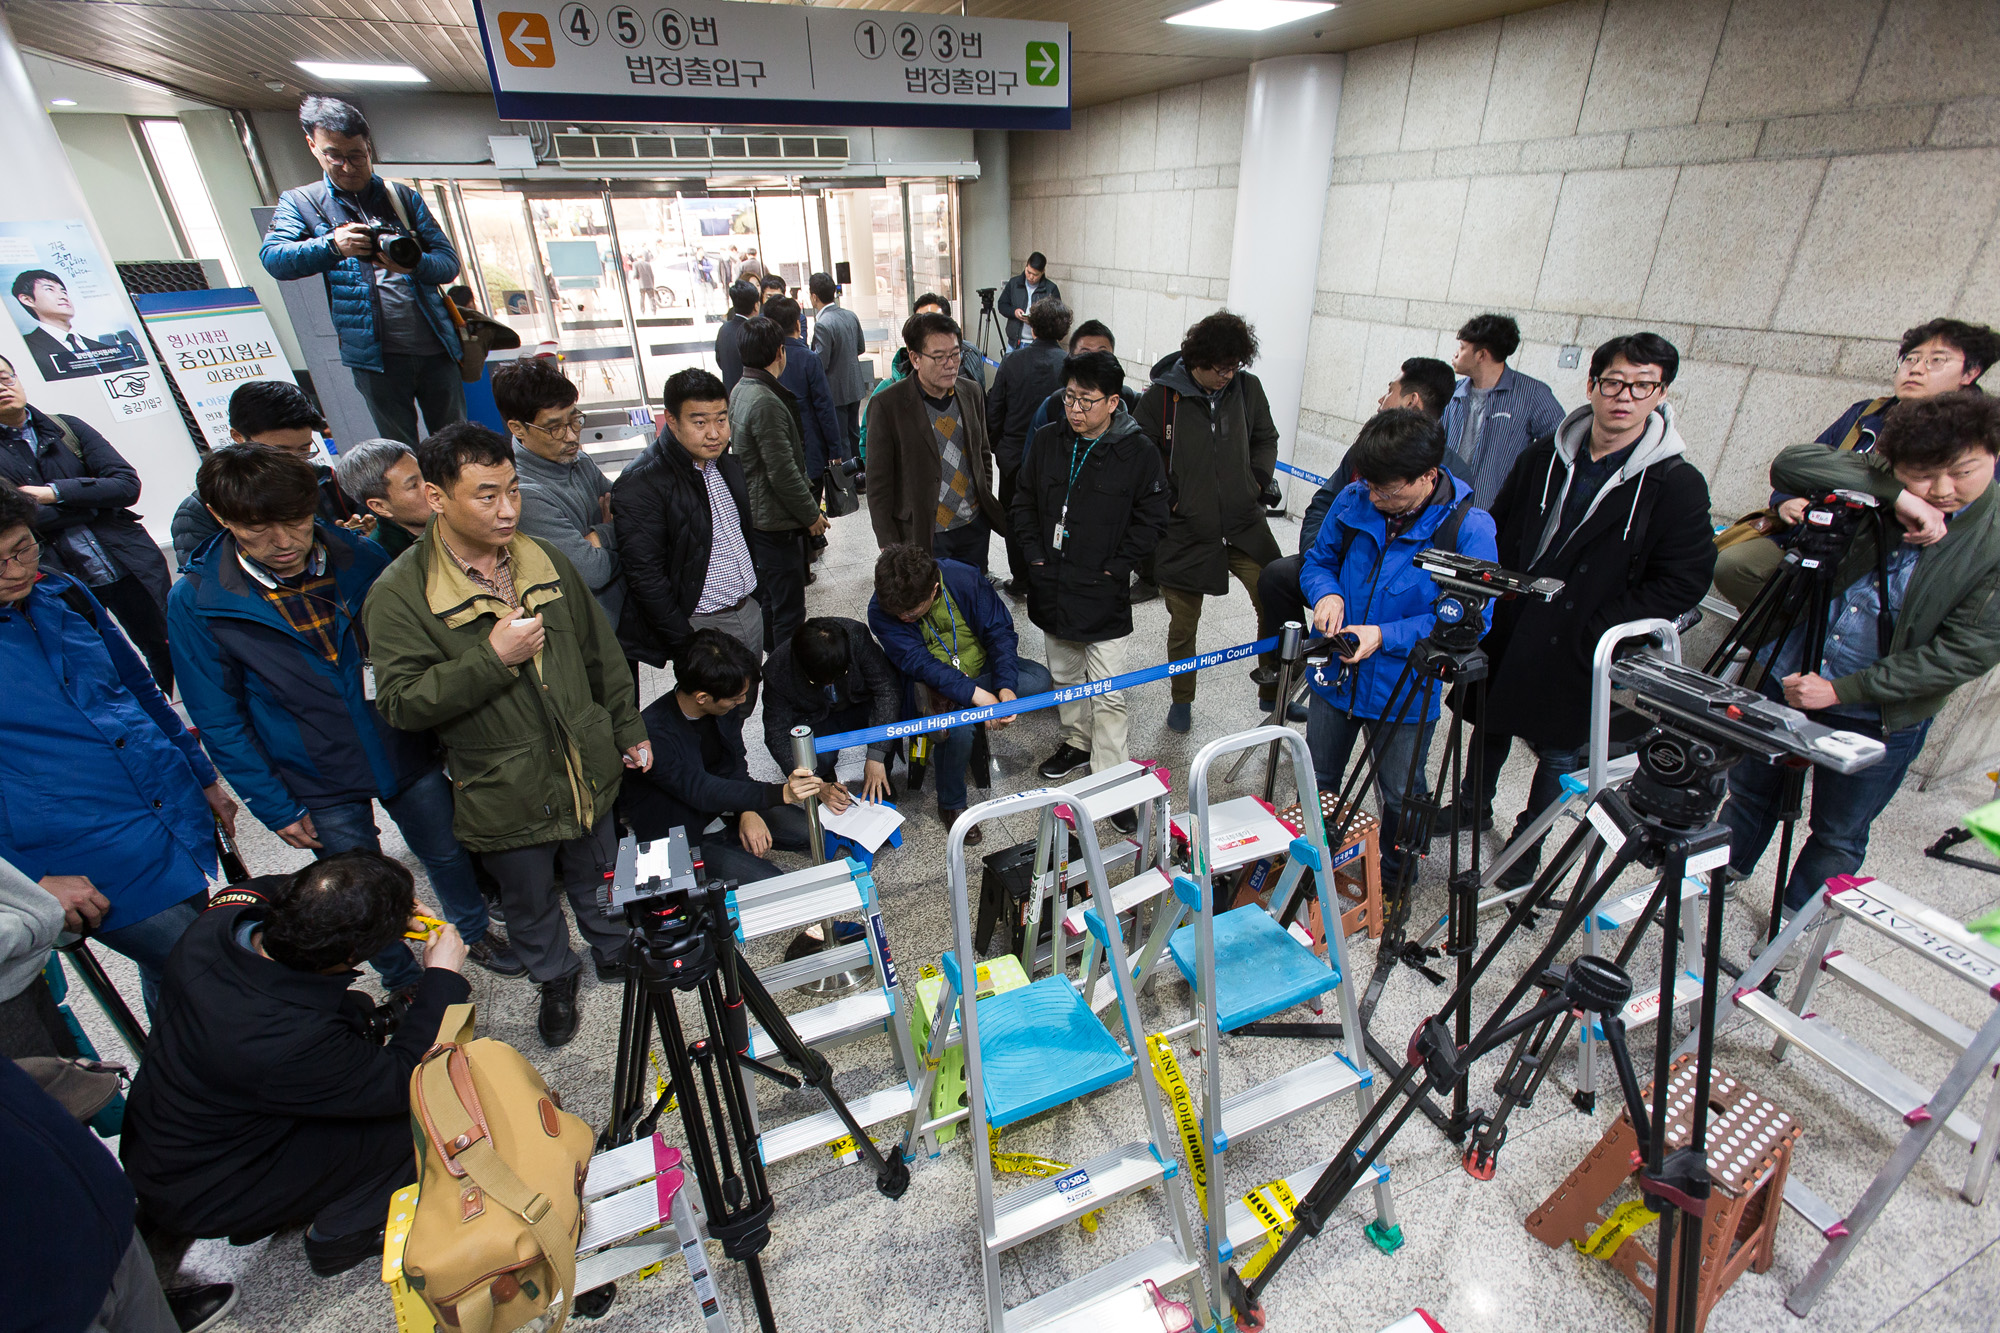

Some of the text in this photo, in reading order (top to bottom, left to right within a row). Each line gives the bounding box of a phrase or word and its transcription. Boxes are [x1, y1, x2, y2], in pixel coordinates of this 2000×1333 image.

[625, 55, 766, 88] 법정출입구
[904, 66, 1018, 97] 법정출입구
[167, 329, 229, 349] 형사재판
[176, 340, 274, 370] 증인지원실
[206, 363, 265, 383] 이용안내
[122, 396, 162, 415] 승강기입구
[1291, 467, 1305, 479] Seoul
[1305, 472, 1317, 483] High
[1168, 645, 1254, 676] Seoul High Court
[1053, 679, 1113, 704] 서울고등법원
[886, 706, 995, 738] Seoul High Court
[1593, 813, 1623, 847] REUTERS
[1694, 851, 1728, 868] REUTERS
[208, 893, 258, 908] Canon
[1160, 1051, 1207, 1187] Canon PHOTO LINE
[1070, 1172, 1088, 1188] SBS
